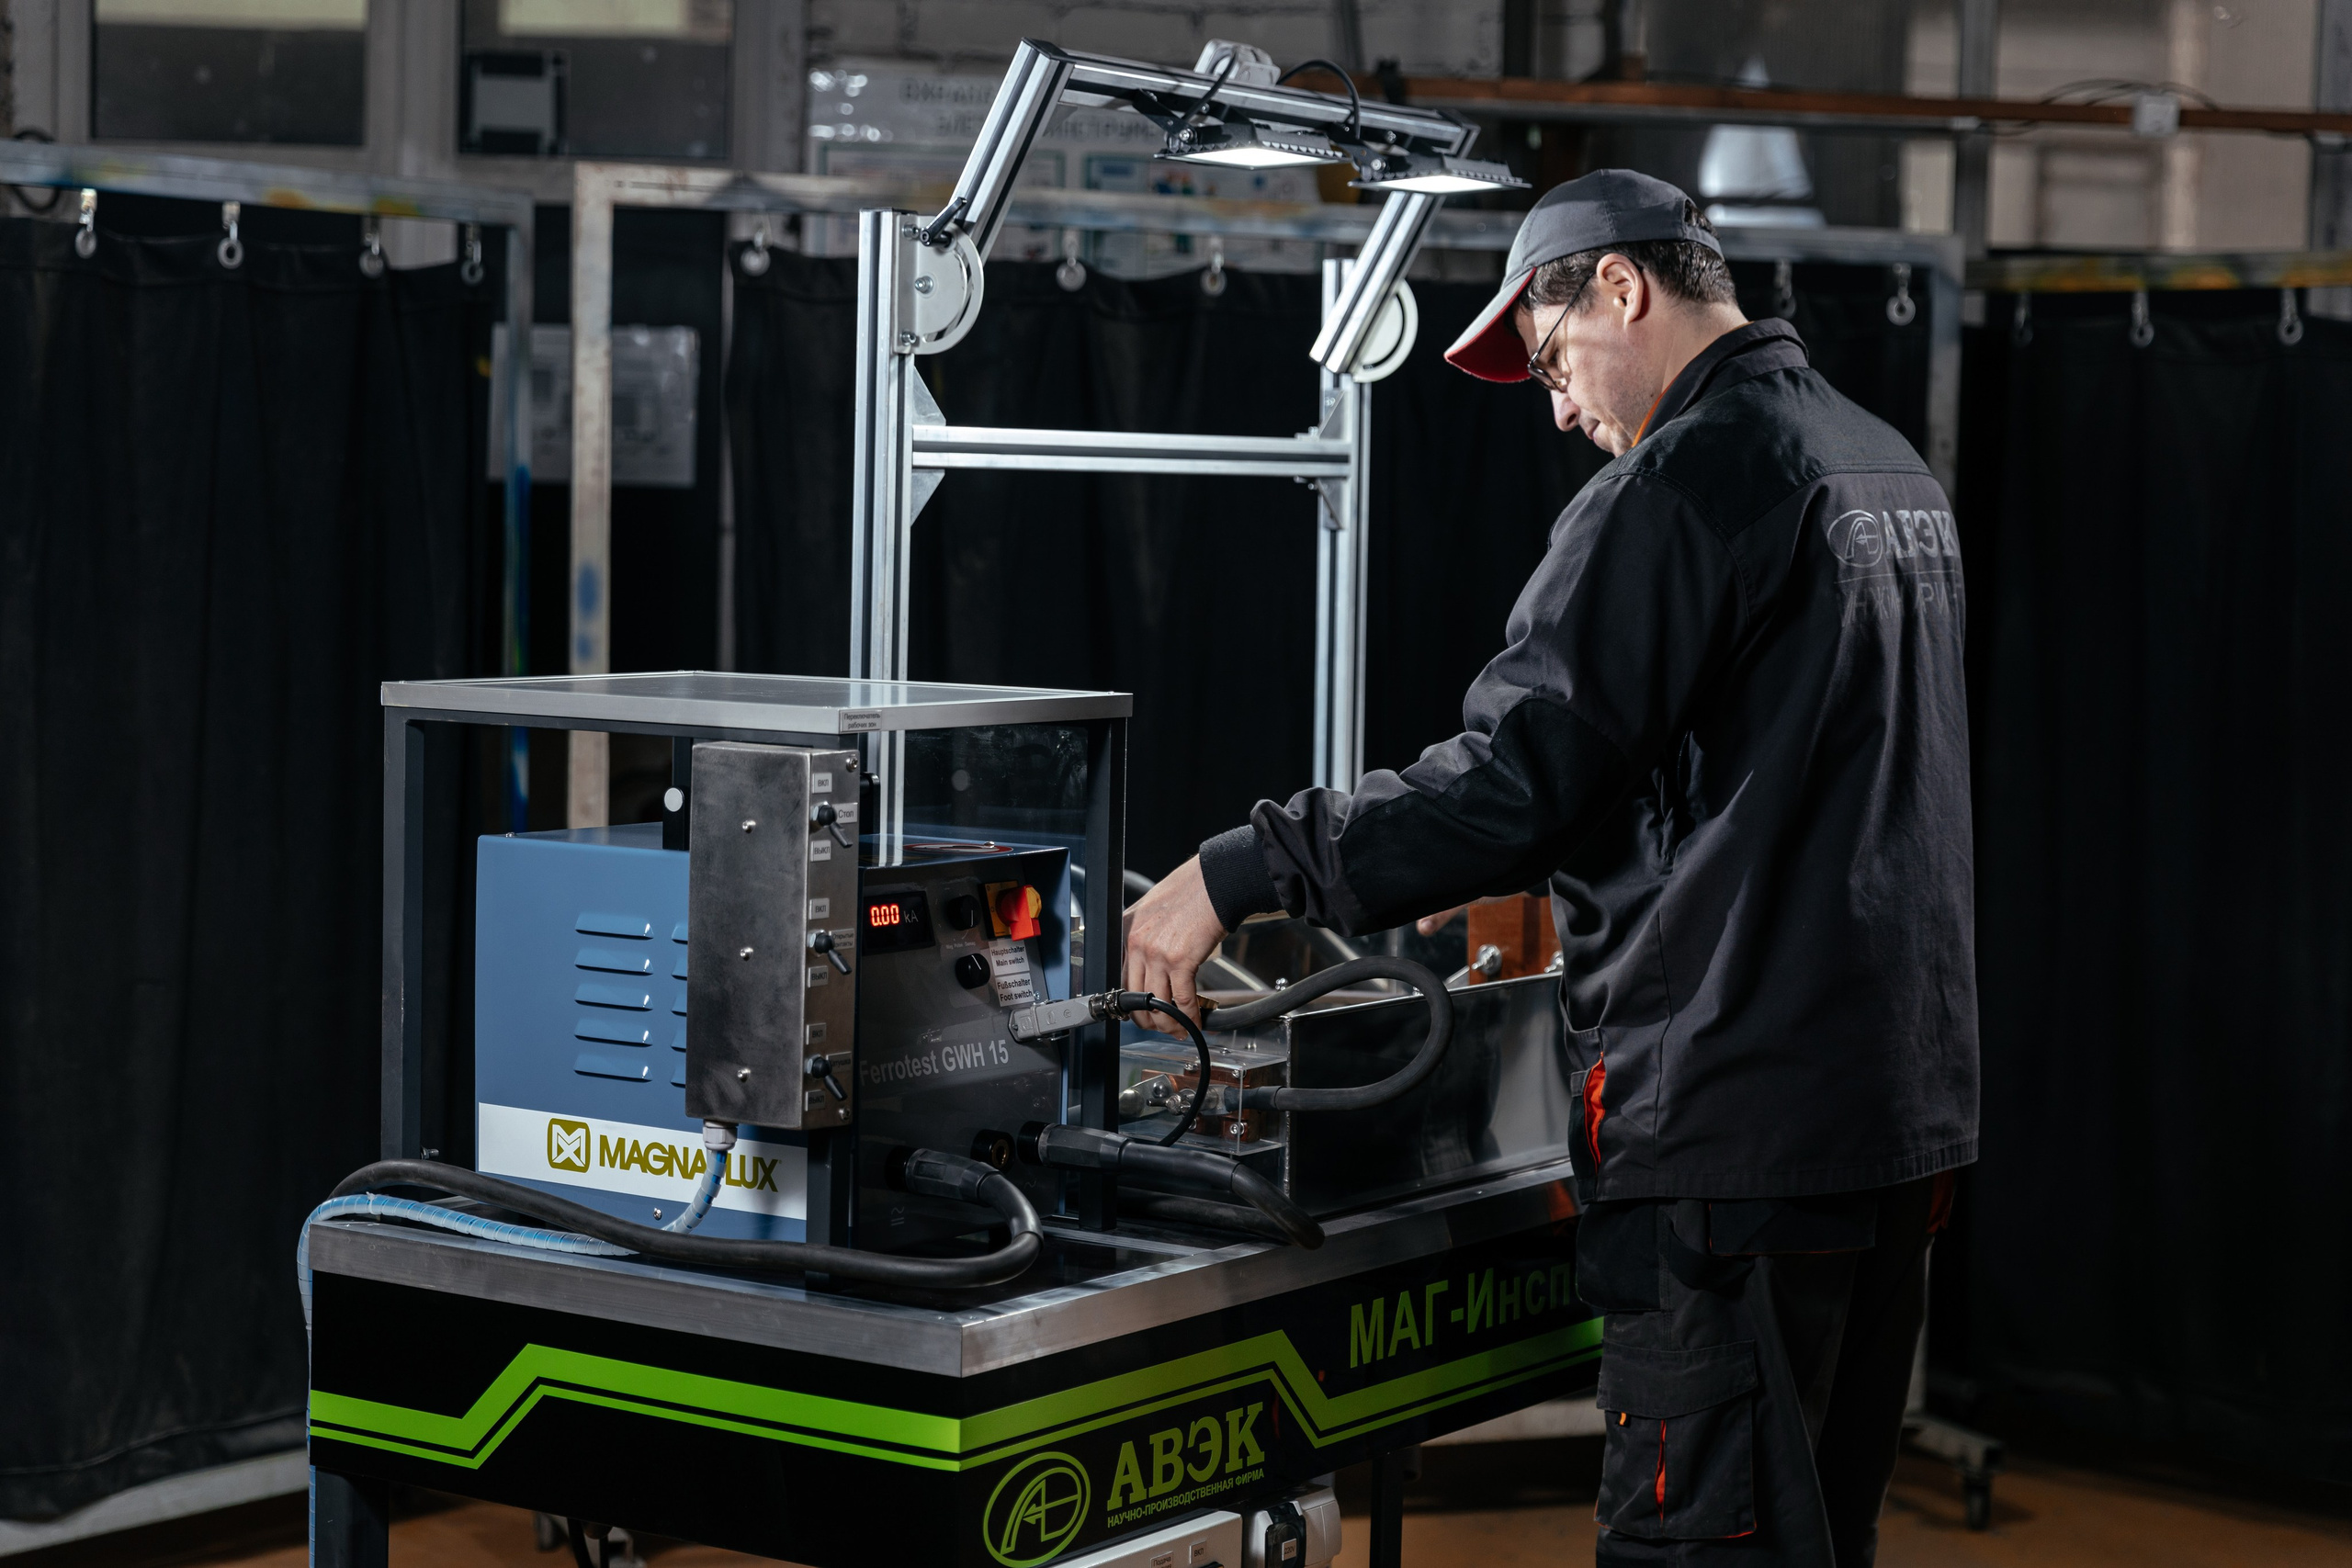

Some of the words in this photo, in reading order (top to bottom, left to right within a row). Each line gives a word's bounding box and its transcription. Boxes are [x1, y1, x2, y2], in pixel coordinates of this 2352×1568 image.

[838, 809, 854, 818] Стоп
[870, 904, 900, 927] 0.00
[903, 910, 919, 924] kA
[834, 941, 854, 949] онтакты
[991, 946, 1025, 956] Hauptschalter
[996, 959, 1009, 967] Main
[1009, 956, 1025, 965] switch
[997, 978, 1031, 990] Fußschalter
[1000, 993, 1013, 1002] Foot
[1014, 989, 1034, 999] switch
[859, 1050, 939, 1087] Ferrotest
[941, 1042, 986, 1072] GWH
[989, 1039, 1009, 1065] 15
[599, 1134, 779, 1193] MAGNALUX
[1106, 1401, 1266, 1512] АВЭК
[1106, 1477, 1234, 1529] НАУЧНО-ПРОИЗВОДСТВЕННАЯ
[1235, 1468, 1265, 1487] ФИРМА
